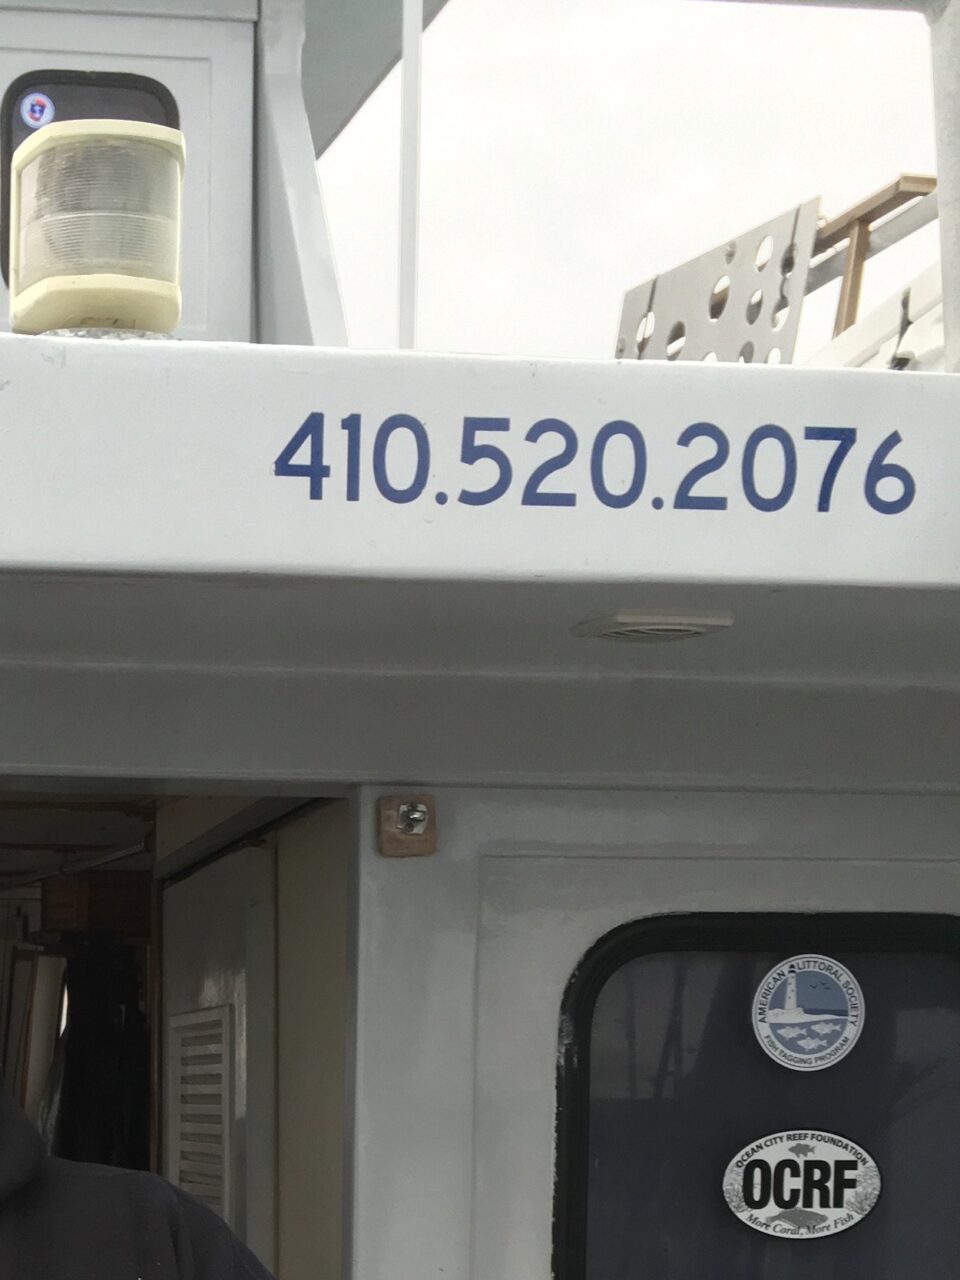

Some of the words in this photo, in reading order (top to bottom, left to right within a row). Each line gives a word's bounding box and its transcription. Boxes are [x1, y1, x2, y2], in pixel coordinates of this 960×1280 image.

[273, 411, 917, 515] 410.520.2076
[758, 970, 786, 1024] AMERICAN
[796, 960, 842, 983] LITTORAL
[841, 980, 859, 1027] SOCIETY
[764, 1034, 779, 1052] FISH
[735, 1142, 765, 1169] OCEAN
[764, 1134, 785, 1148] CITY
[786, 1132, 809, 1142] REEF
[810, 1133, 870, 1167] FOUNDATION
[742, 1158, 859, 1210] OCRF
[745, 1212, 771, 1231] More
[833, 1213, 855, 1229] Fish
